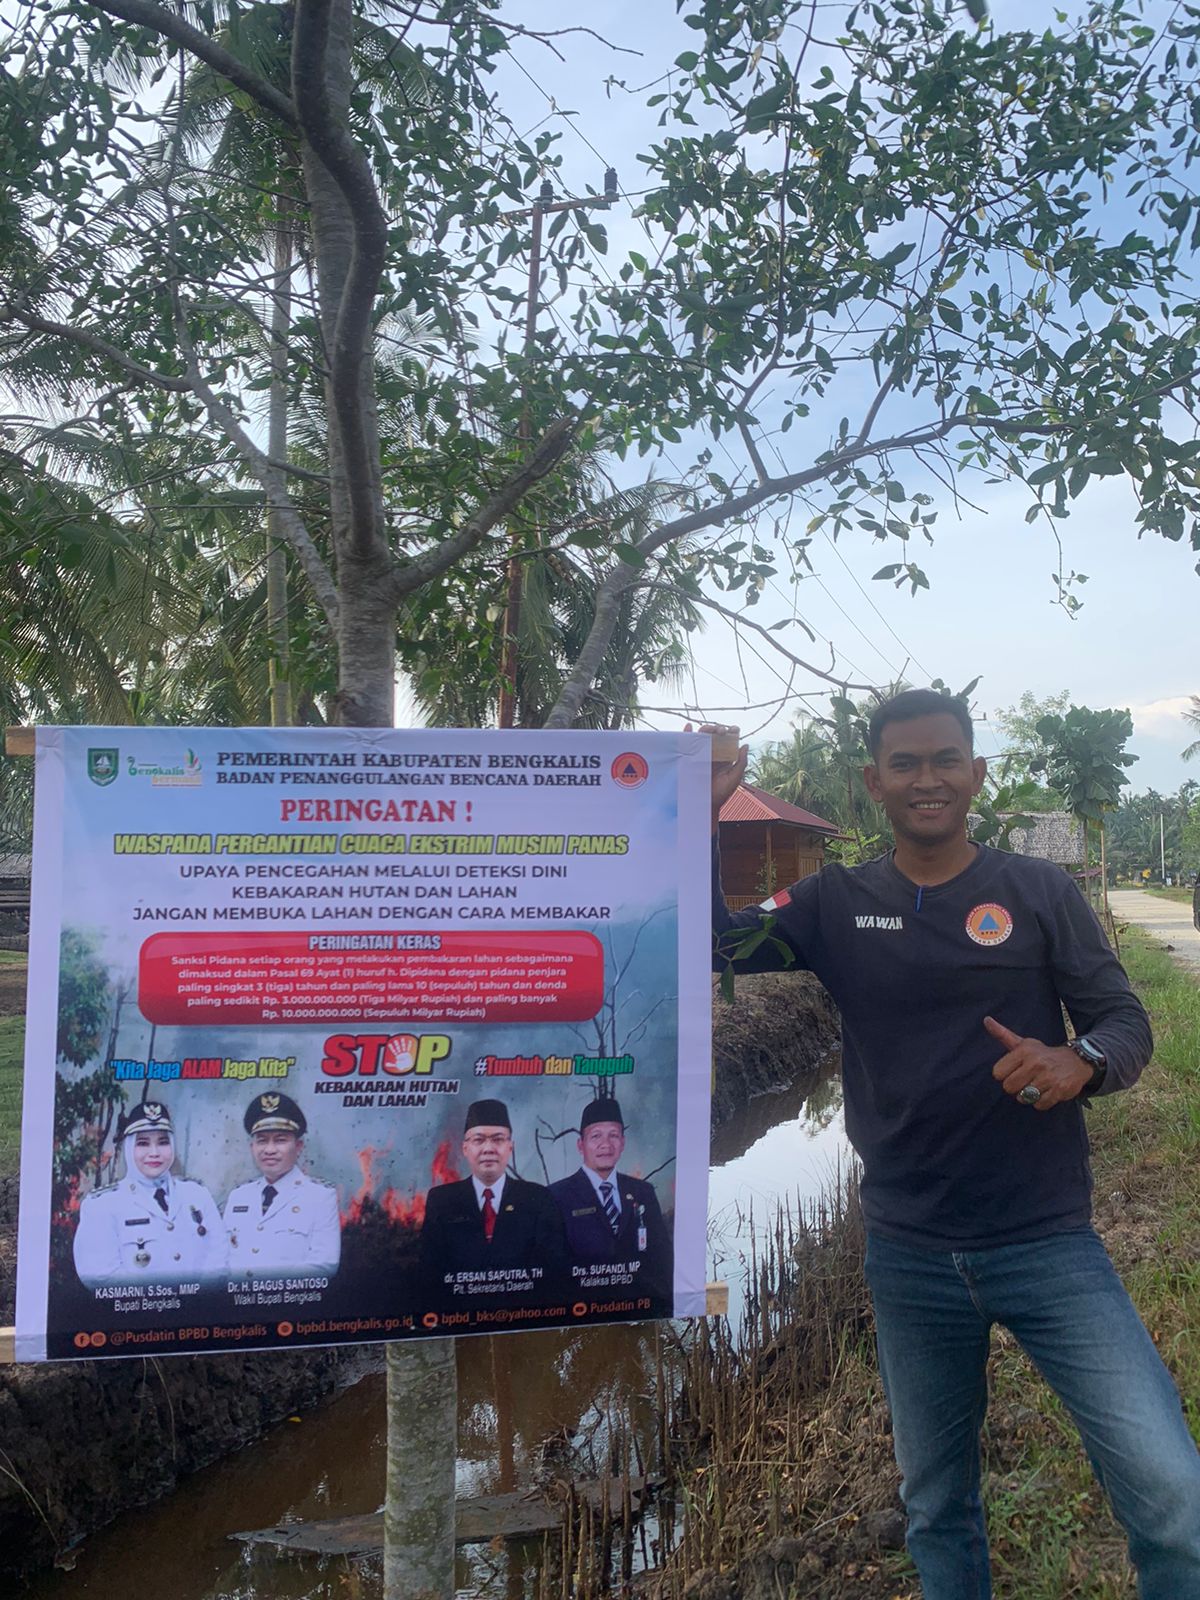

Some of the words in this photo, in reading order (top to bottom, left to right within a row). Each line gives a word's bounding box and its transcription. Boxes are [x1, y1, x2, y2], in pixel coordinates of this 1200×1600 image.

[217, 752, 356, 767] PEMERINTAH
[363, 753, 482, 768] KABUPATEN
[488, 755, 601, 769] BENGKALIS
[216, 772, 275, 785] BADAN
[280, 772, 445, 786] PENANGGULANGAN
[451, 774, 529, 786] BENCANA
[534, 774, 602, 787] DAERAH
[280, 799, 456, 823] PERINGATAN
[114, 834, 212, 855] WASPADA
[215, 834, 337, 855] PERGANTIAN
[340, 834, 406, 855] CUACA
[409, 834, 494, 855] EKSTRIM
[496, 835, 564, 855] MUSIM
[566, 835, 629, 855] PANAS
[180, 866, 240, 878] UPAYA
[245, 865, 369, 878] PENCEGAHAN
[375, 865, 450, 878] MELALUI
[456, 865, 527, 878] DETEKSI
[532, 865, 567, 878] DINI
[232, 886, 343, 899] KEBAKARAN
[350, 886, 409, 899] HUTAN
[415, 886, 451, 898] DAN
[458, 886, 517, 898] LAHAN
[133, 907, 207, 920] JANGAN
[213, 907, 305, 920] MEMBUKA
[312, 907, 371, 920] LAHAN
[379, 907, 452, 919] DENGAN
[458, 907, 504, 919] CARA
[511, 906, 611, 919] MEMBAKAR
[854, 915, 904, 930] WAWAN
[309, 935, 393, 950] PERINGATAN
[397, 935, 441, 950] KERAS
[171, 956, 206, 965] Sanksi
[209, 956, 246, 965] Pidana
[249, 955, 280, 966] setiap
[283, 957, 314, 966] orang
[317, 957, 343, 966] yang
[346, 955, 403, 964] melakukan
[407, 955, 472, 965] pembakaran
[474, 954, 502, 963] lahan
[505, 954, 573, 965] sebagaimana
[178, 969, 231, 978] dimaksud
[234, 968, 267, 978] dalam
[270, 968, 298, 978] Pasal
[301, 968, 313, 978] 69
[316, 968, 340, 979] Ayat
[356, 968, 386, 977] huruf
[400, 967, 446, 978] Dipidana
[448, 967, 487, 977] dengan
[490, 966, 525, 977] pidana
[528, 967, 566, 978] penjara
[177, 983, 211, 994] paling
[214, 982, 253, 993] singkat
[257, 982, 263, 991] 3
[265, 982, 293, 993] (tiga)
[296, 981, 327, 991] tahun
[330, 981, 349, 991] dan
[352, 981, 385, 992] paling
[388, 981, 413, 990] lama
[416, 980, 427, 990] 10
[429, 980, 477, 991] (sepuluh)
[479, 980, 510, 990] tahun
[512, 980, 532, 989] dan
[534, 980, 567, 989] denda
[187, 996, 222, 1007] paling
[223, 996, 260, 1005] sedikit
[262, 996, 280, 1006] Rp.
[282, 996, 357, 1005] 3.000.000.000
[359, 995, 385, 1005] (Tiga
[387, 994, 419, 1005] Milyar
[421, 994, 461, 1005] Rupiah)
[463, 994, 483, 1003] dan
[486, 993, 518, 1004] paling
[520, 993, 558, 1004] banyak
[262, 1009, 280, 1019] Rp.
[364, 1007, 410, 1018] (Sepuluh
[412, 1007, 444, 1018] Milyar
[446, 1007, 486, 1018] Rupiah)
[321, 1033, 451, 1077] STOP
[181, 1058, 222, 1080] ALAM
[222, 1057, 256, 1081] Jaga
[314, 1080, 406, 1095] KEBAKARAN
[410, 1079, 459, 1093] HUTAN
[343, 1095, 375, 1107] DAN
[378, 1094, 427, 1107] LAHAN
[444, 1272, 455, 1283] dr.
[457, 1271, 487, 1282] ERSAN
[488, 1269, 530, 1281] SAPUTRA,
[531, 1268, 543, 1278] TH
[572, 1265, 588, 1277] Drs.
[590, 1263, 628, 1275] SUFANDI,
[629, 1261, 641, 1272] MP
[227, 1281, 240, 1294] Dr.
[241, 1281, 251, 1292] H.
[252, 1280, 284, 1292] BAGUS
[286, 1277, 329, 1290] SANTOSO
[506, 1280, 534, 1292] Daerah
[580, 1276, 610, 1287] Kalaksa
[611, 1274, 633, 1285] BPBD
[95, 1287, 145, 1300] KASMARNI,
[179, 1284, 200, 1295] MMP
[233, 1293, 257, 1306] Wakil
[258, 1293, 282, 1305] Bupati
[282, 1291, 322, 1305] Bengkalis
[114, 1300, 140, 1313] Bupati
[142, 1298, 181, 1312] Bengkalis
[590, 1300, 635, 1313] Pusdatin
[637, 1298, 651, 1309] PB
[441, 1305, 566, 1326] bpbd_bks@yahoo.com
[296, 1317, 414, 1335] bpbd.bengkalis.go.id
[110, 1330, 175, 1346] @Pusdatin
[178, 1328, 209, 1341] BPBD
[212, 1325, 267, 1340] Bengkalis
